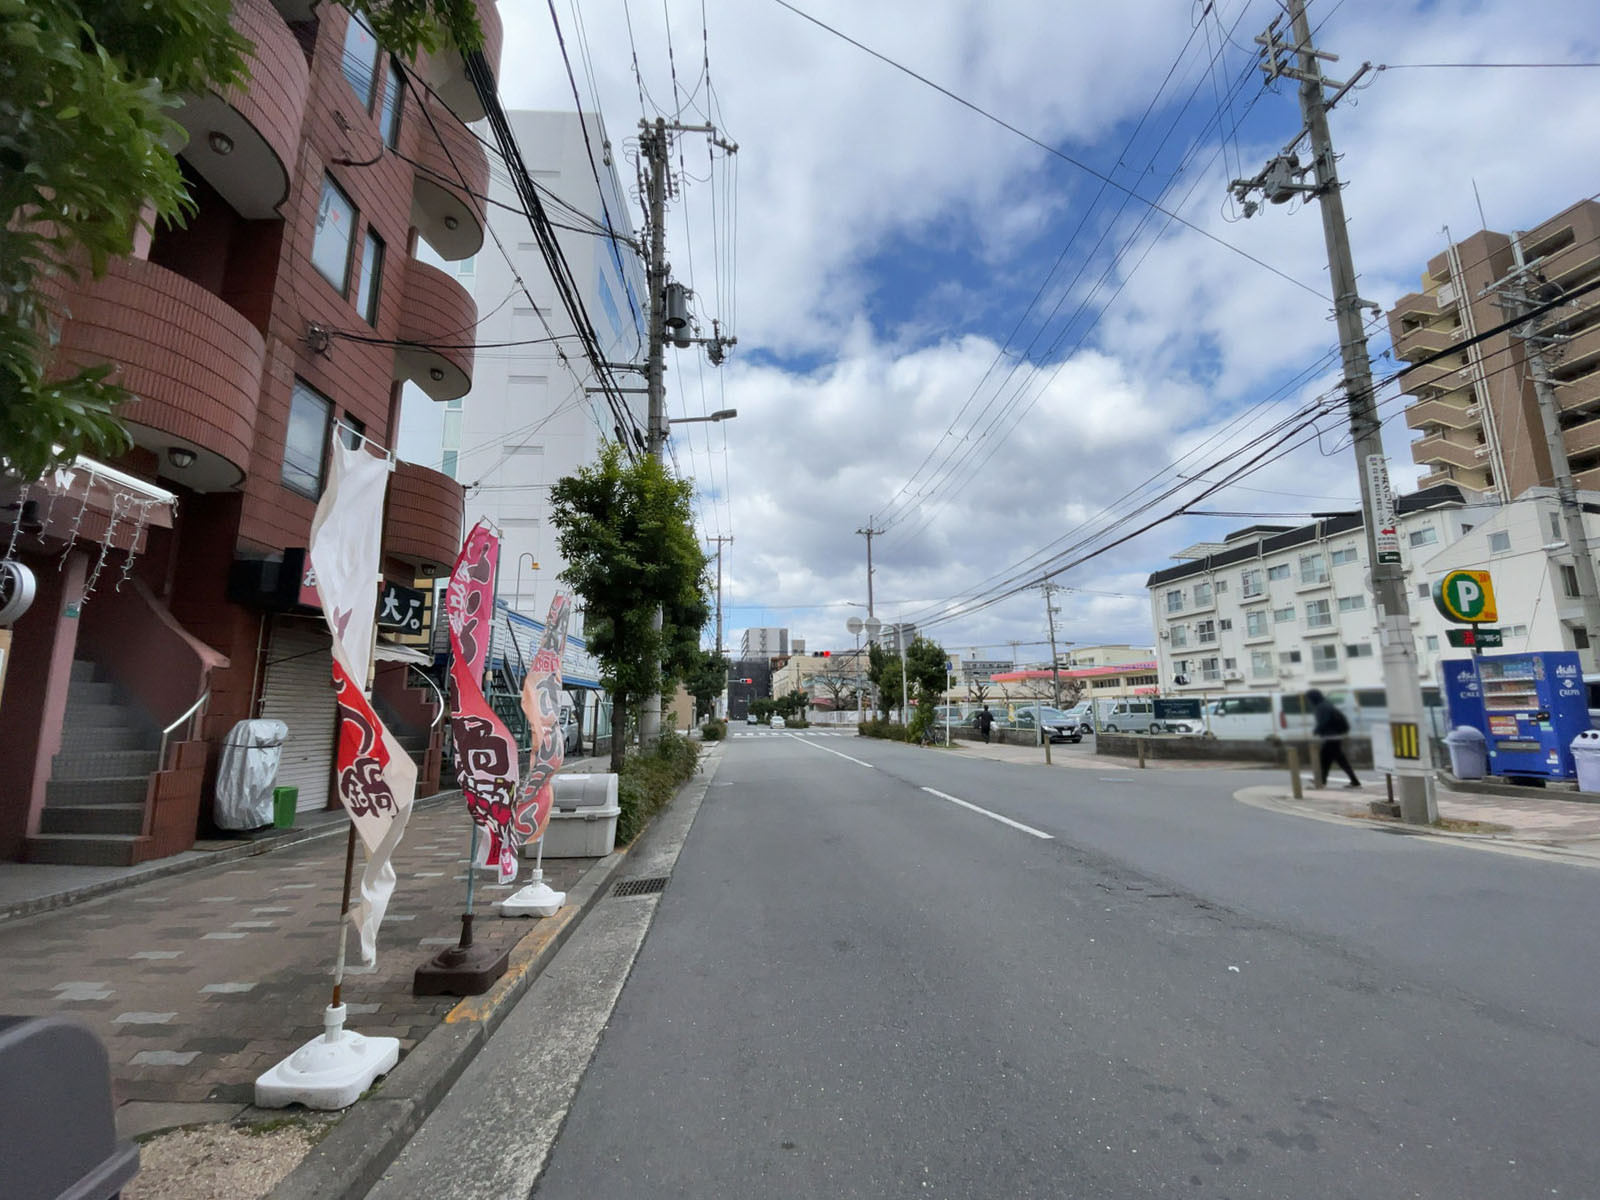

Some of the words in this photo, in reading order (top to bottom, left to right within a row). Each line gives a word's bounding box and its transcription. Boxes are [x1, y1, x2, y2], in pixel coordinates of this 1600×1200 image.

[381, 587, 421, 630] 大石
[1456, 580, 1479, 612] P
[1556, 665, 1577, 674] Asahi
